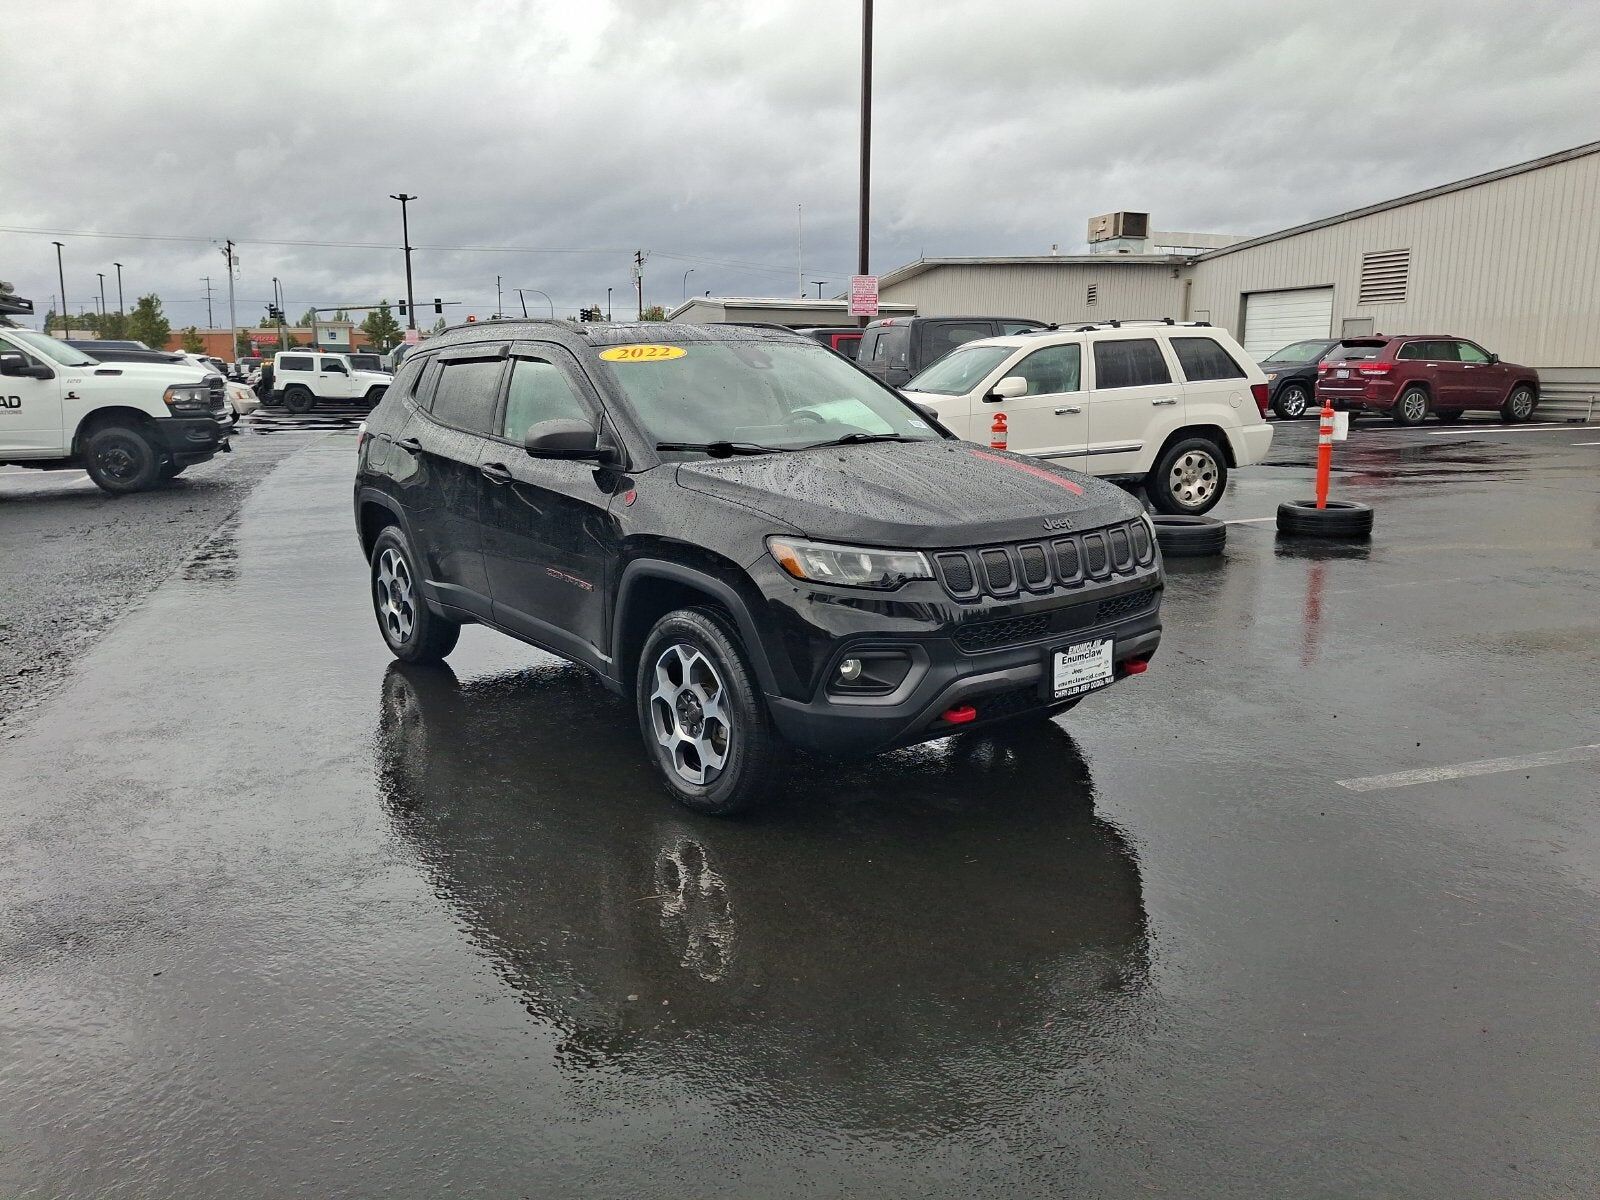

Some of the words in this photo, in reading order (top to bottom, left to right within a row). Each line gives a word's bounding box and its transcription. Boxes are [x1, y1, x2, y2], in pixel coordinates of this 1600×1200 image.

[616, 347, 670, 360] 2022
[1042, 518, 1072, 531] Jeep
[1062, 648, 1103, 665] Enumclaw
[1080, 683, 1091, 692] JEEP
